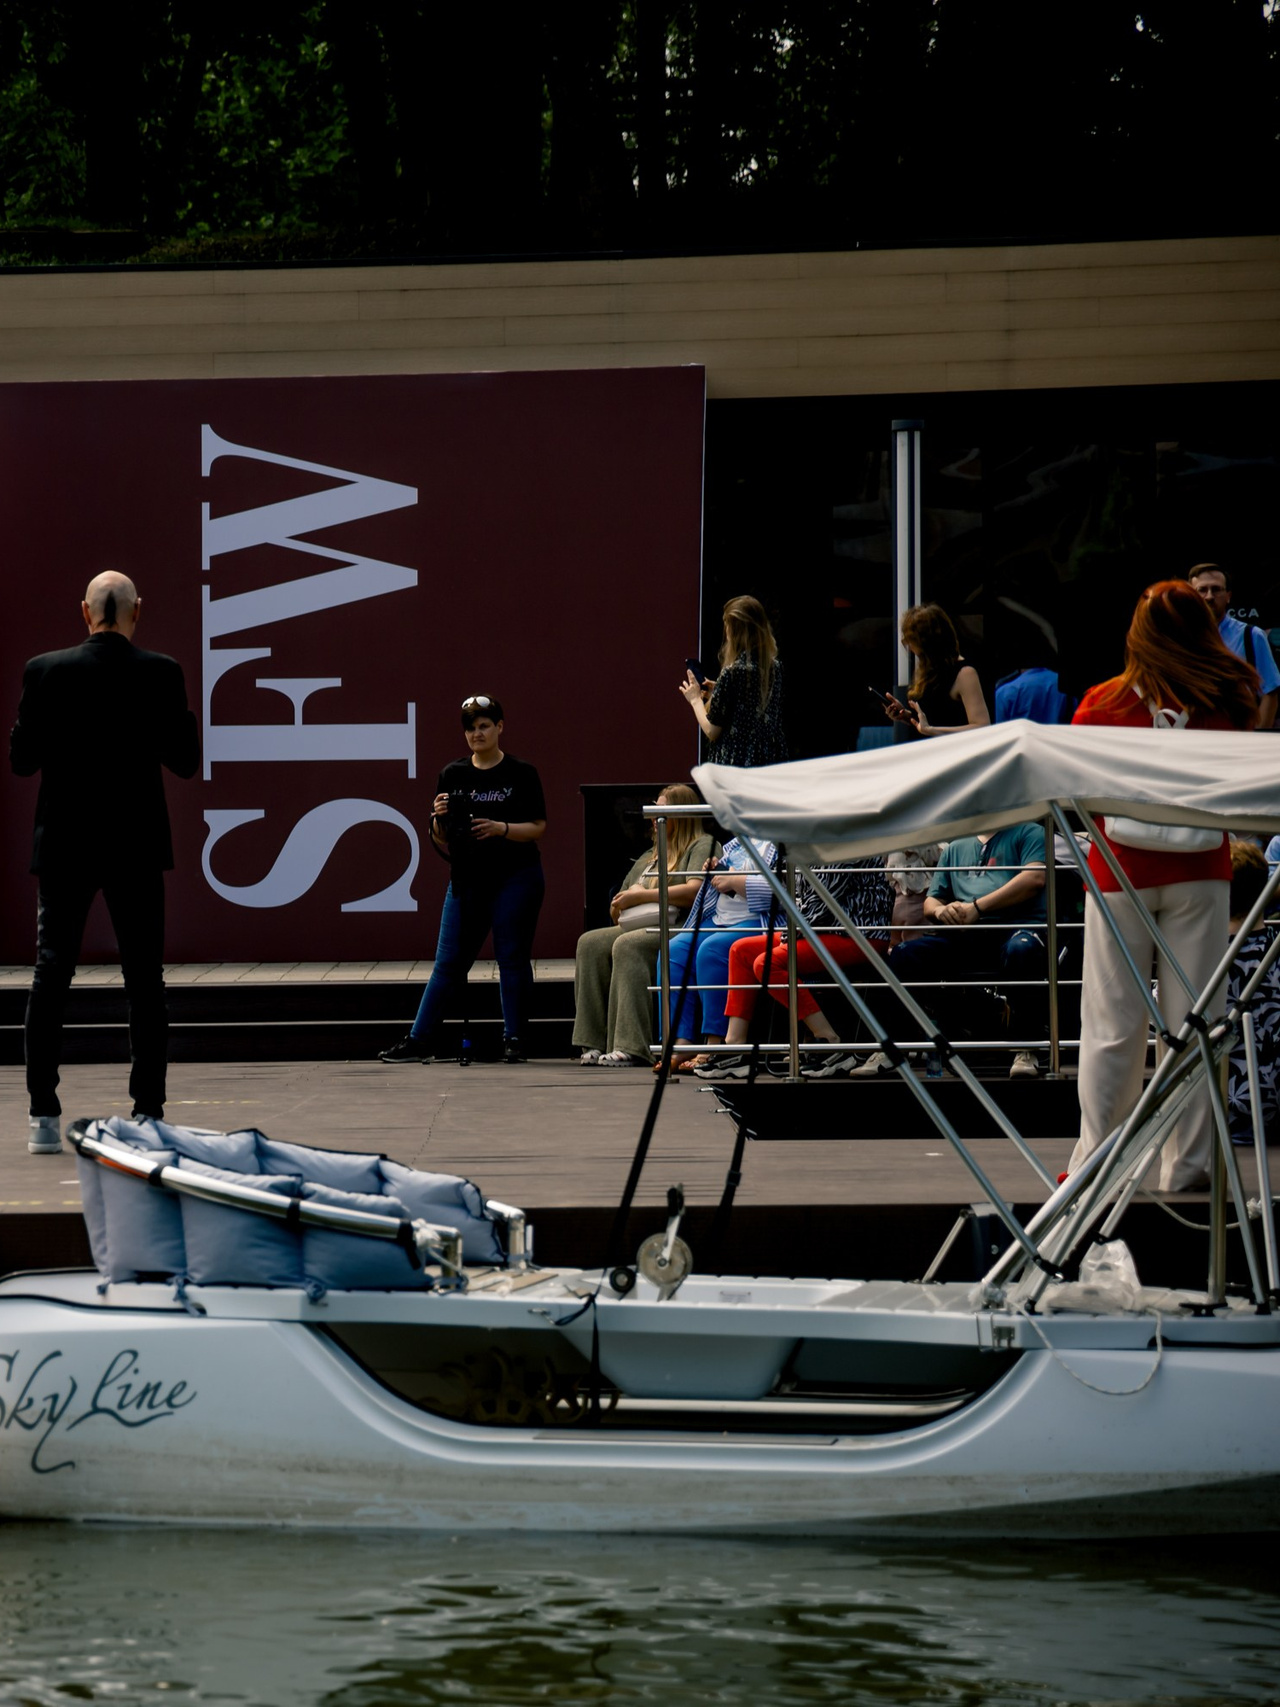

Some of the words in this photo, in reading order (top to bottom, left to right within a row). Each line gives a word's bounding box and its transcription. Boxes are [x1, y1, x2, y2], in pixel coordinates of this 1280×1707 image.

[201, 424, 420, 912] SFW
[470, 789, 506, 802] balife
[65, 1349, 197, 1428] Line
